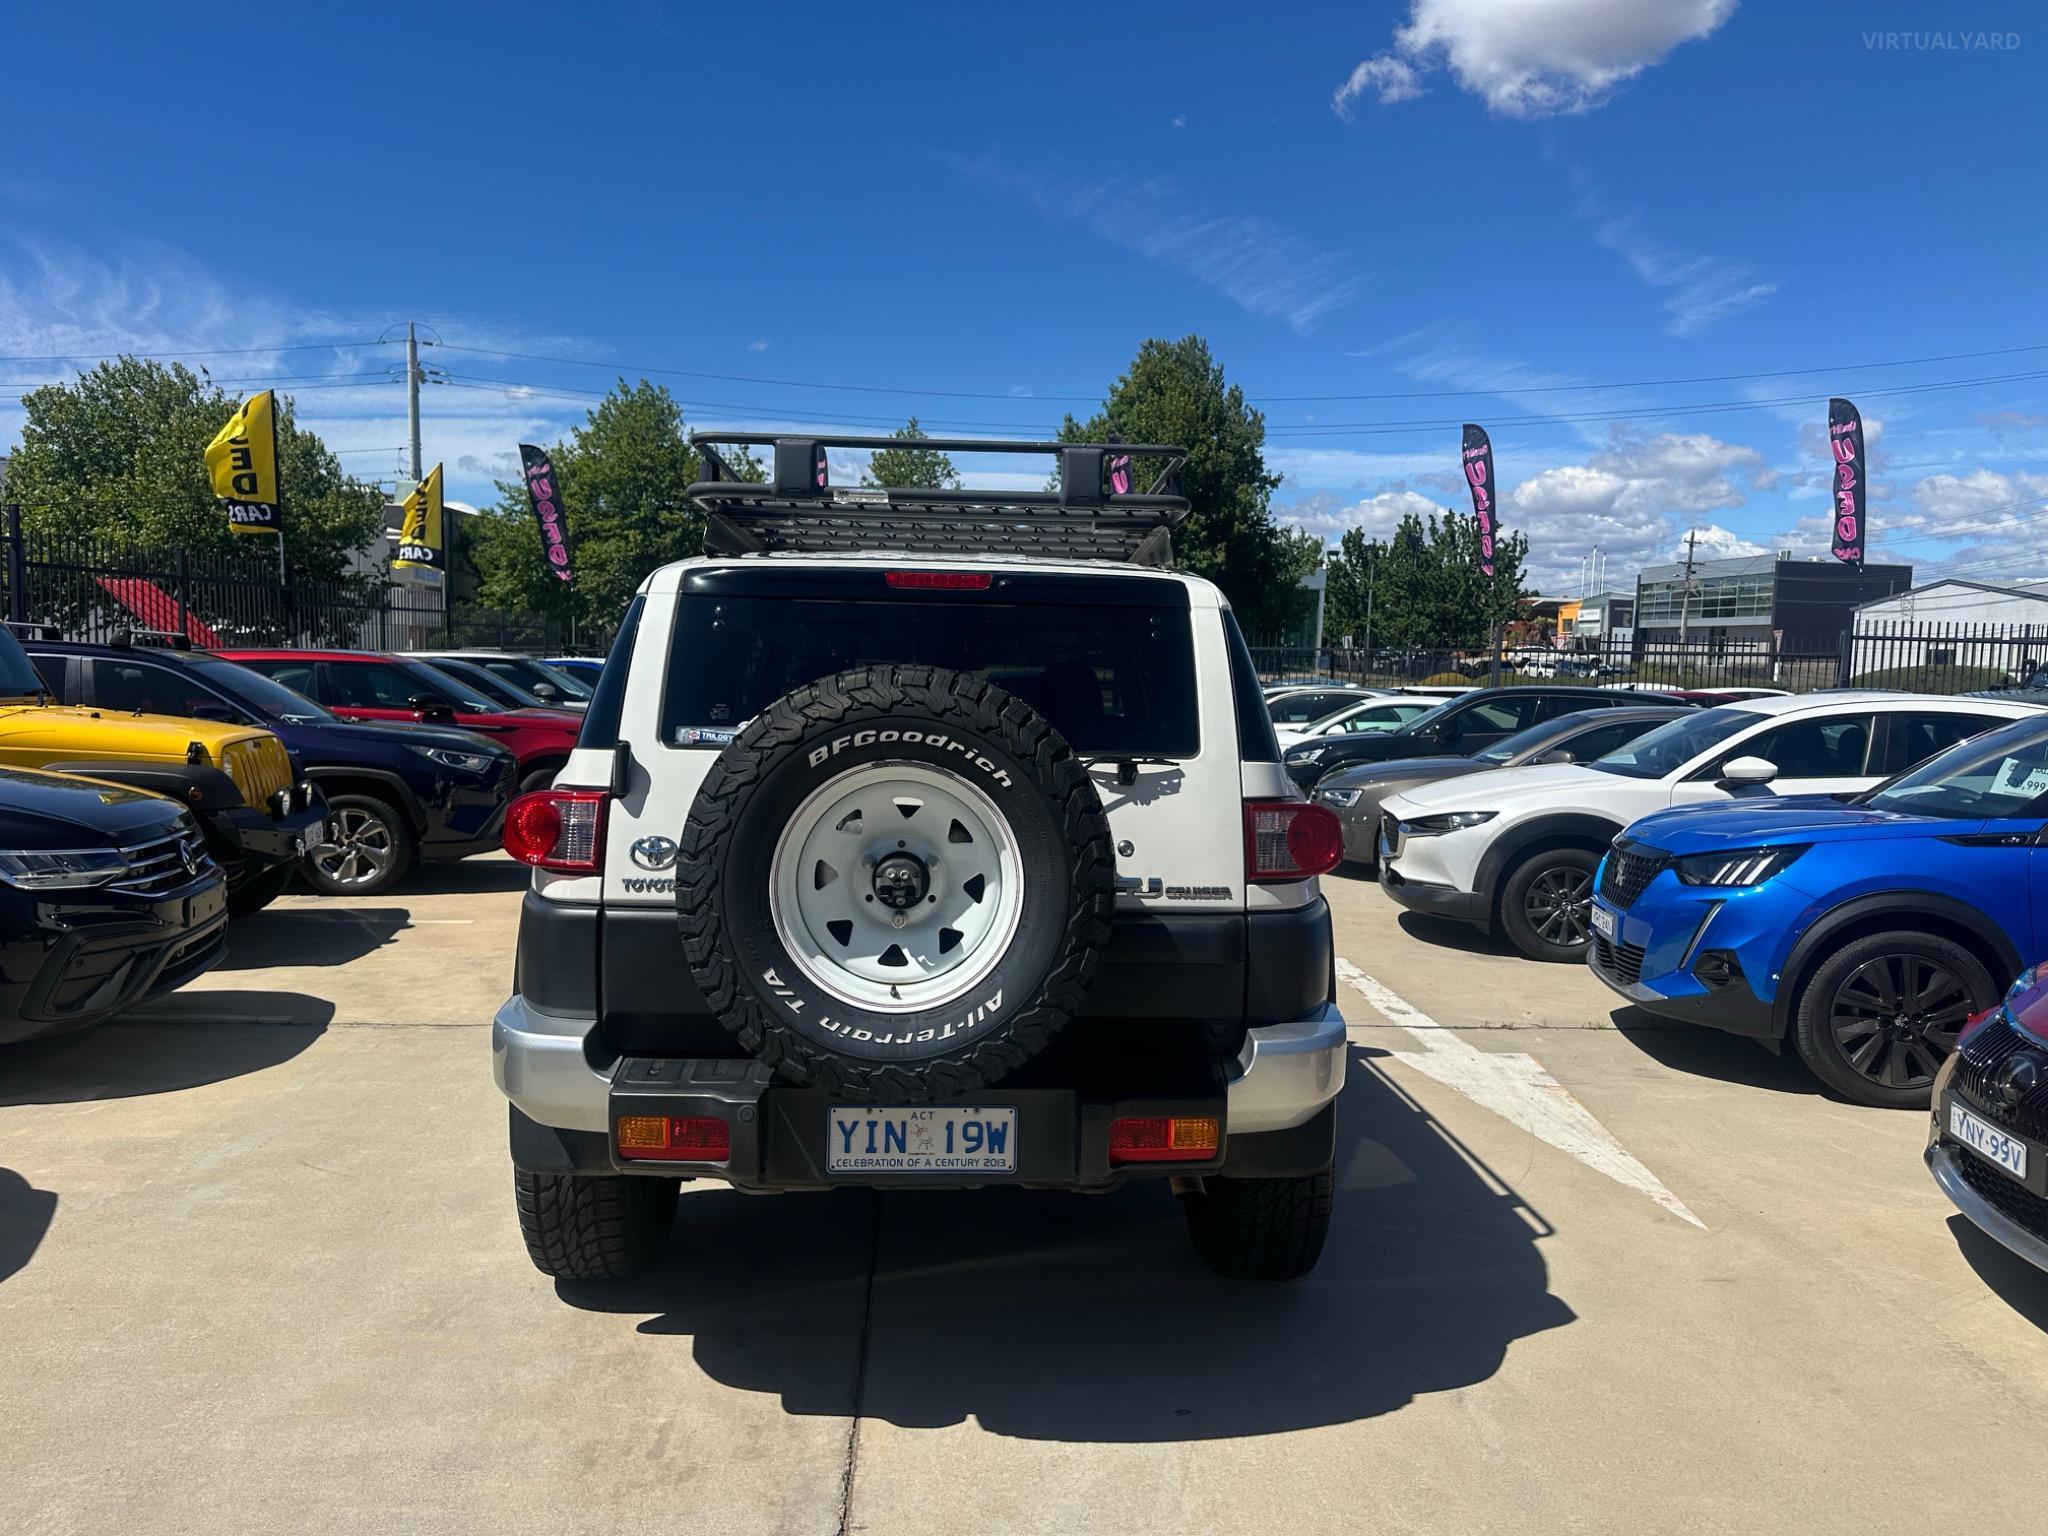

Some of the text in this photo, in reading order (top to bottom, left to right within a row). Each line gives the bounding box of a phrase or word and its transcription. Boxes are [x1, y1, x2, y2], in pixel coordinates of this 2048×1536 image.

[808, 729, 1013, 788] BFGoodrich
[622, 878, 677, 893] TOYOT
[763, 966, 1003, 1044] All-Terrain T/A
[911, 1111, 934, 1120] ACT
[837, 1120, 1008, 1154] YIN 19W
[836, 1158, 1006, 1168] CELEBRATION OF A CENTURY 2013
